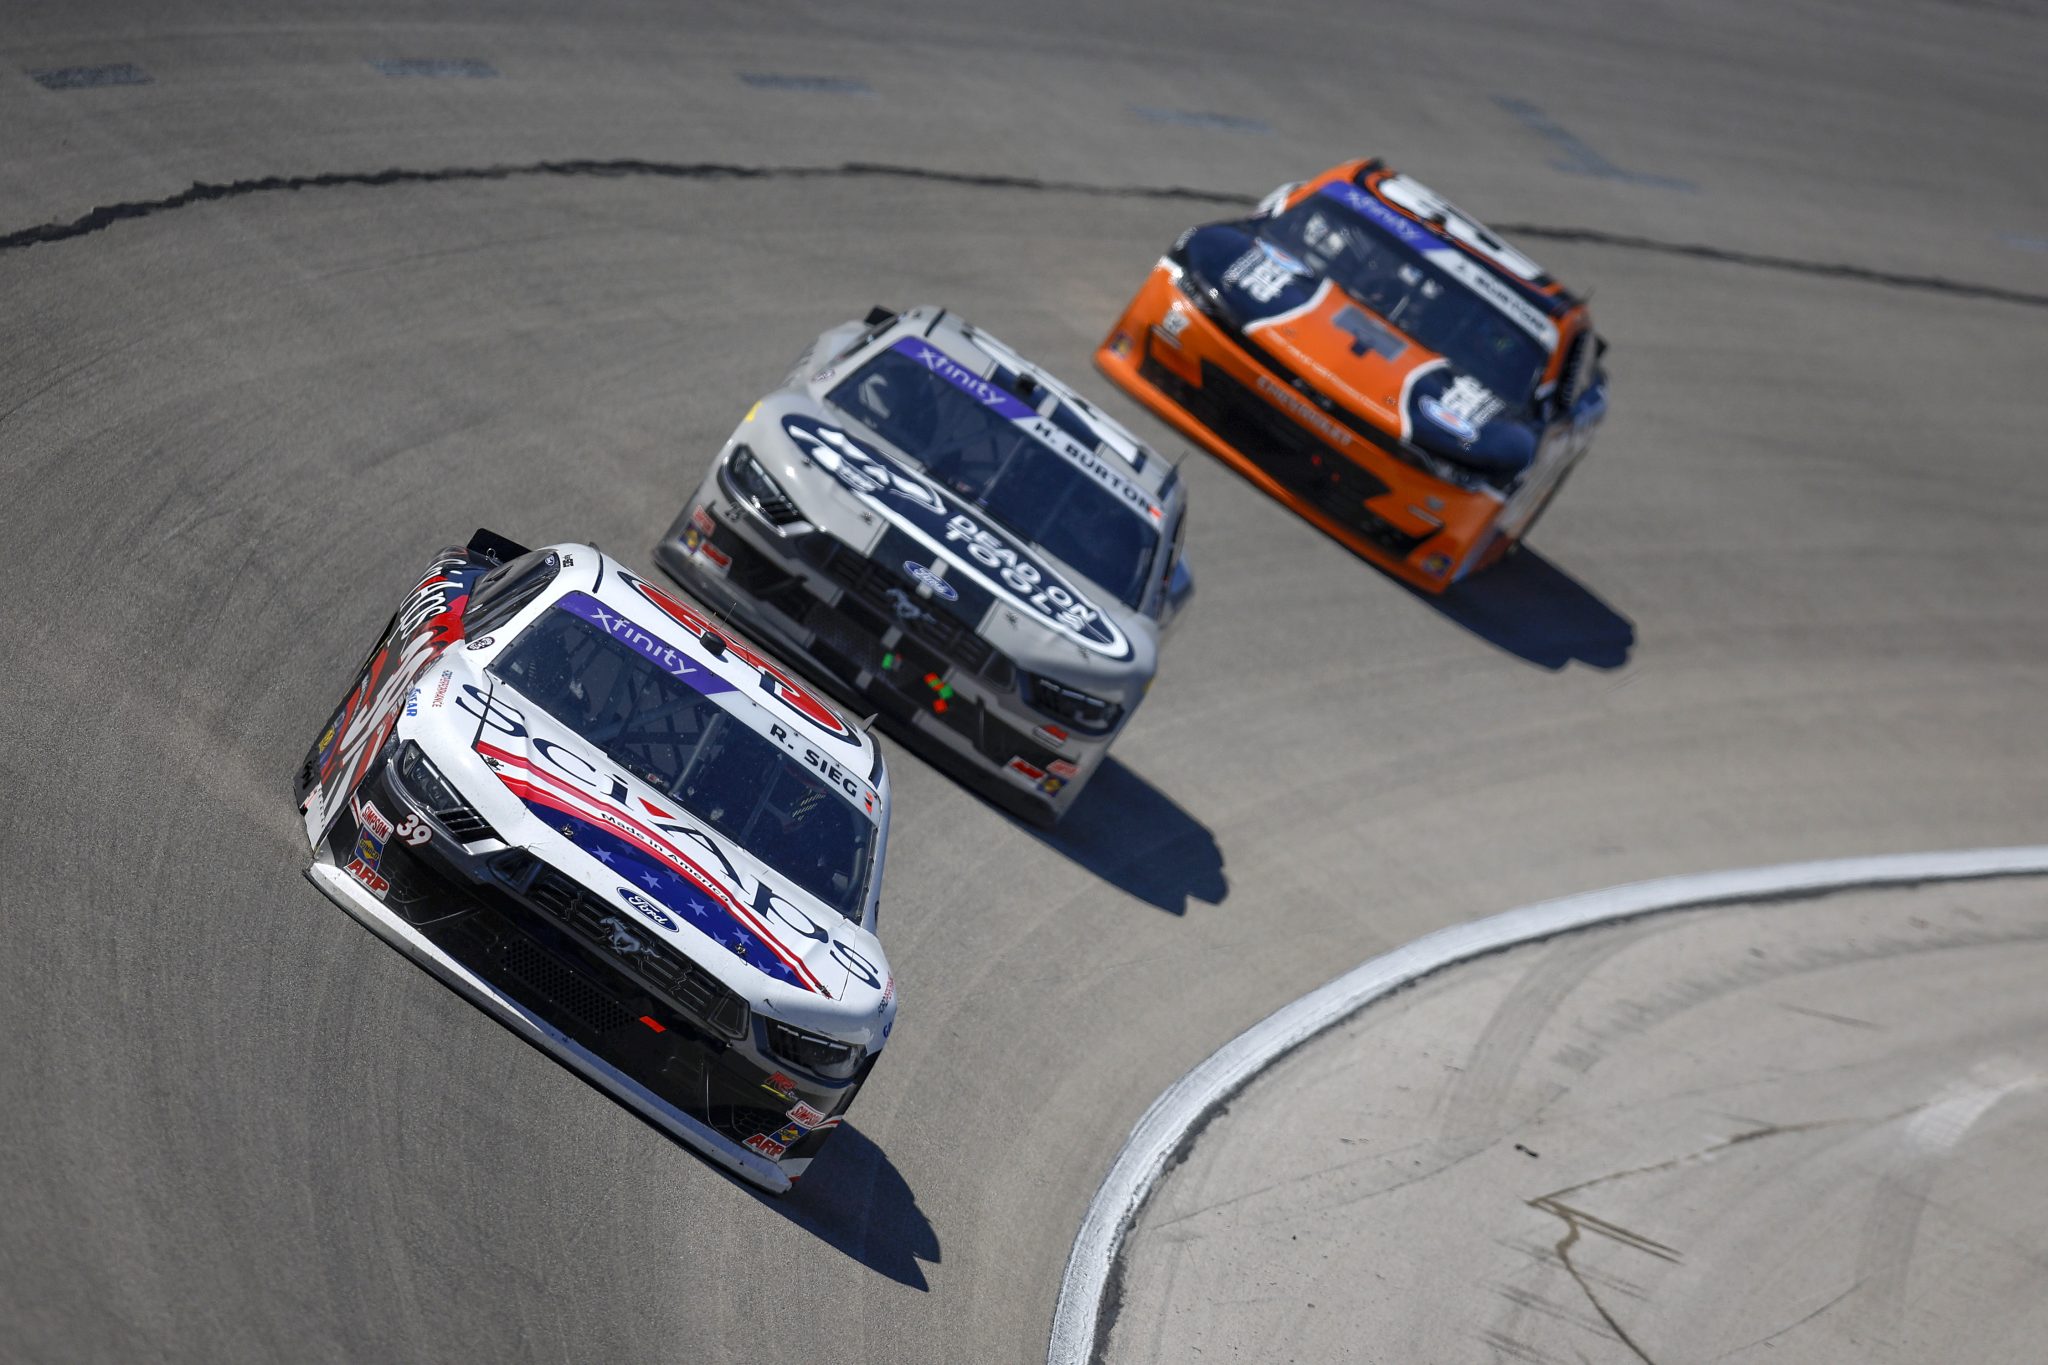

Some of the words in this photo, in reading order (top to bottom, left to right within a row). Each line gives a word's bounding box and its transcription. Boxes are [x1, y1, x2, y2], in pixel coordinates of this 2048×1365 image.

[916, 347, 1006, 407] xfinity
[1033, 421, 1057, 446] H.
[1064, 440, 1153, 512] BURTON
[945, 523, 1087, 634] TOOLS
[948, 515, 1041, 583] DEAD
[1047, 586, 1098, 623] ON
[590, 607, 697, 676] xfinity
[770, 723, 795, 751] R.
[804, 748, 858, 798] SIEG
[359, 804, 389, 839] SIMPSON
[396, 813, 433, 847] 39
[347, 859, 390, 893] ARP
[601, 812, 644, 840] Made
[649, 838, 664, 854] in
[668, 845, 731, 903] America
[628, 893, 670, 927] Ford
[746, 1133, 787, 1157] ARP
